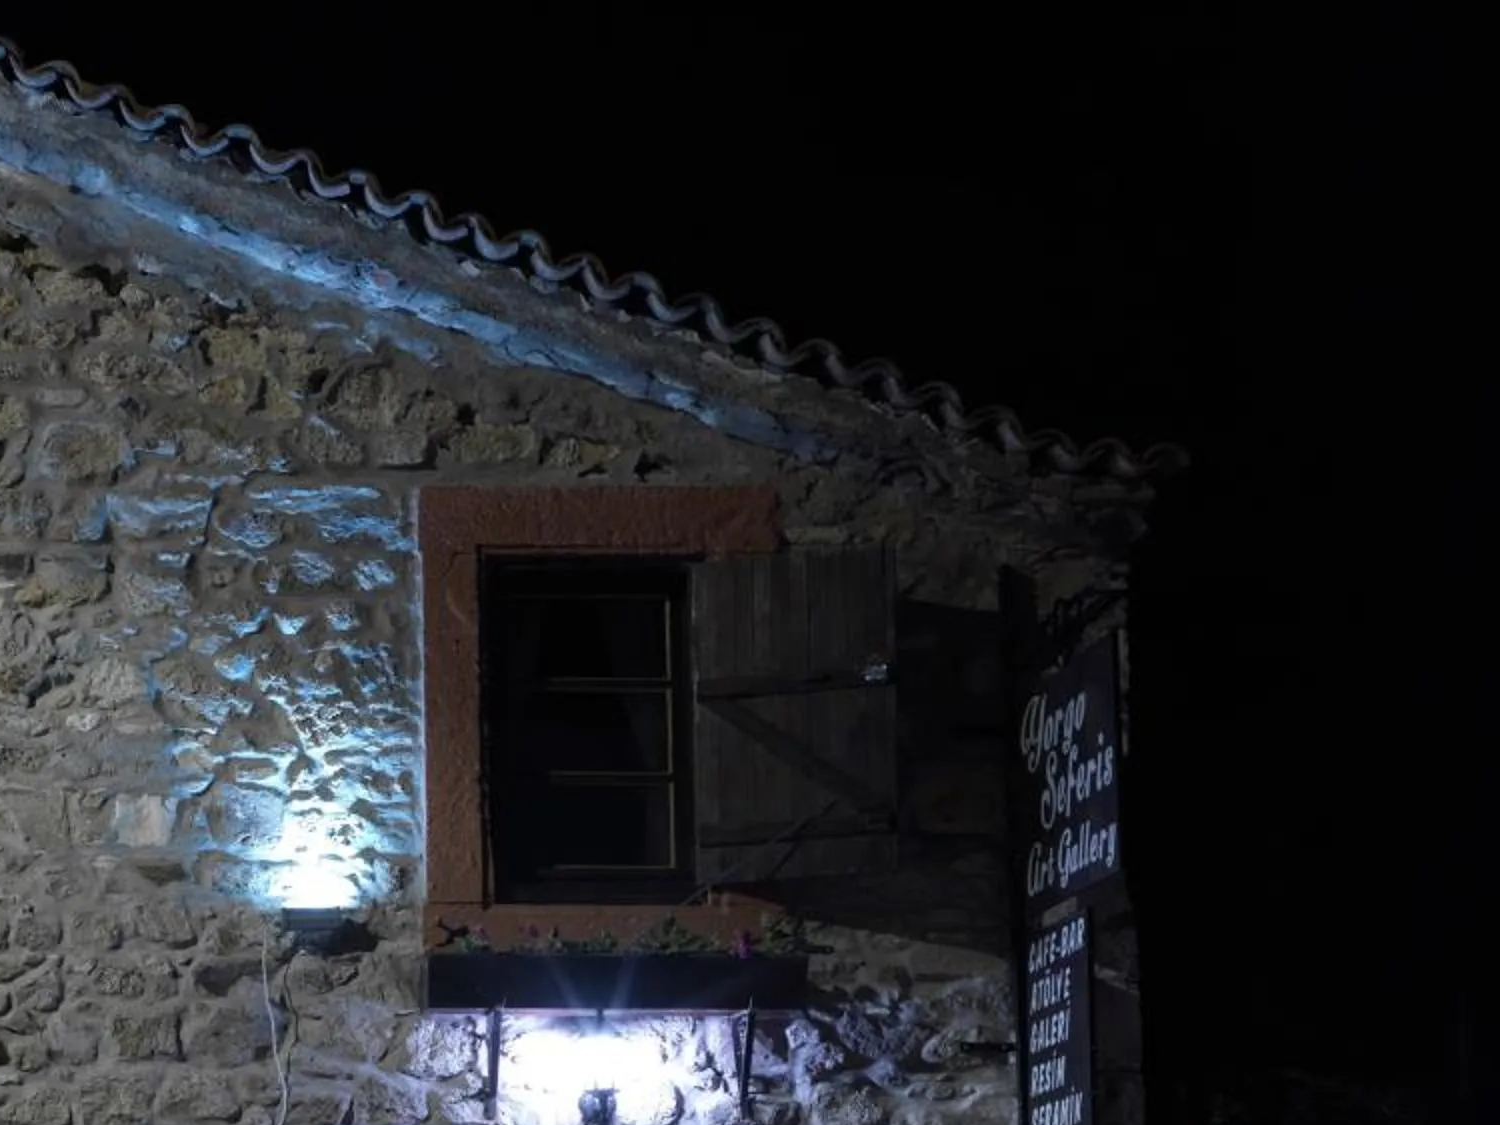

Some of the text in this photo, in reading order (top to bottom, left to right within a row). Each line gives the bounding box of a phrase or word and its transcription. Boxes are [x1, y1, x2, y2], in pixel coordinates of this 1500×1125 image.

[1041, 732, 1113, 828] Seferis
[1057, 821, 1118, 889] Gallery
[1029, 917, 1085, 973] CAFE-BAR
[1030, 968, 1071, 1014] ATÖLYE
